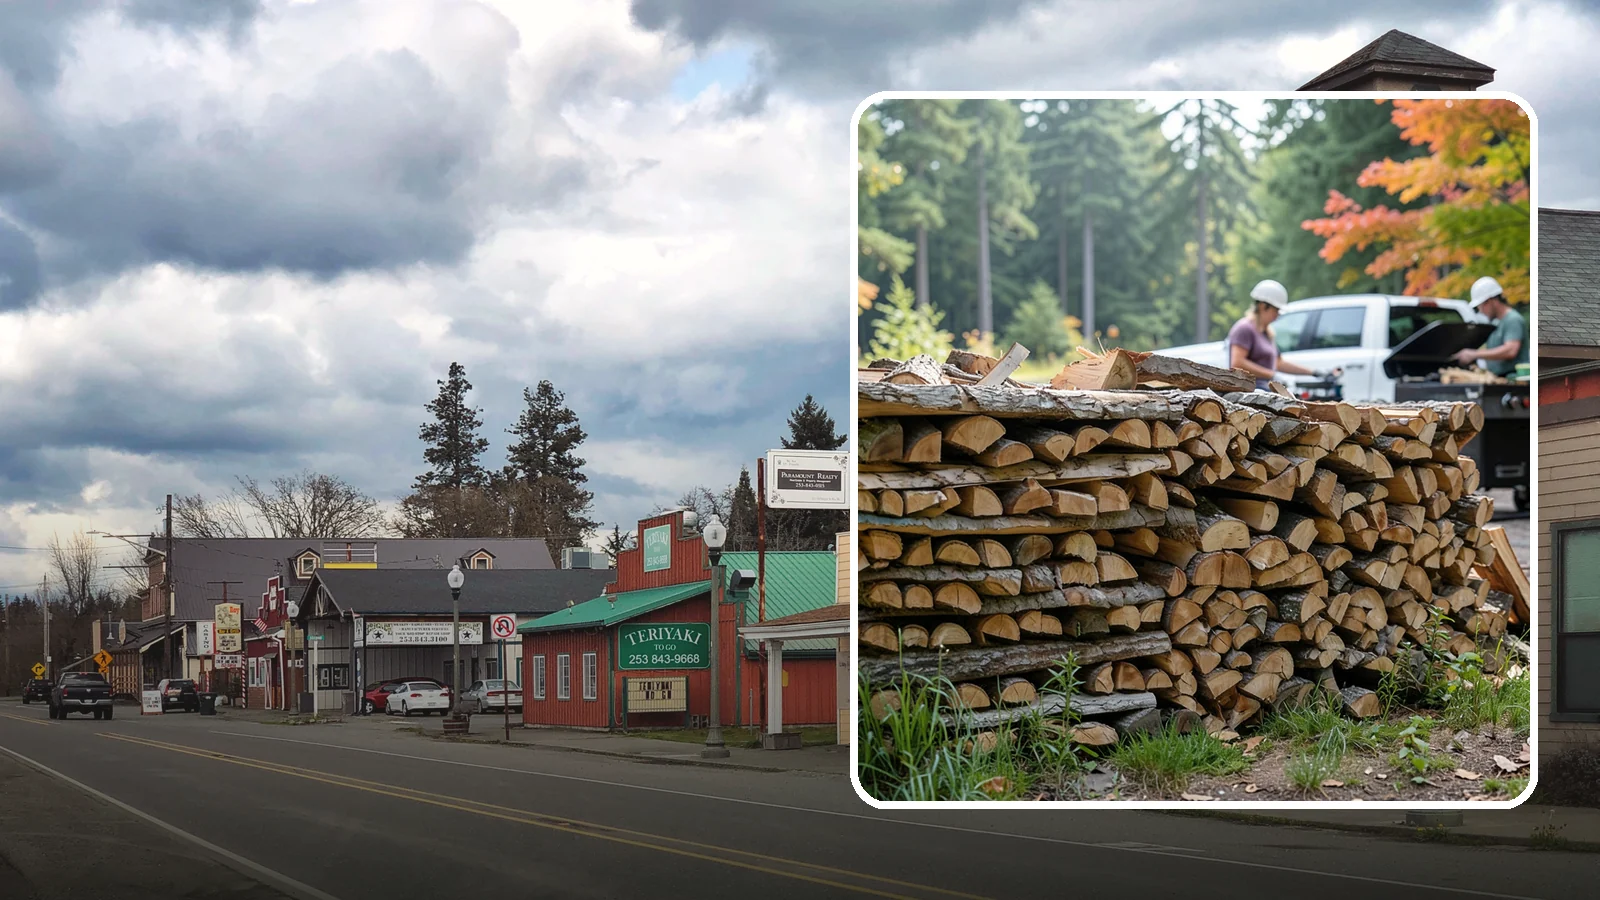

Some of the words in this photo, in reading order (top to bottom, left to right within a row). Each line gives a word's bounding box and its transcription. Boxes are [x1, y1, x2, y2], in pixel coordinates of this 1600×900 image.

[624, 627, 702, 646] TERIYAKI
[628, 654, 649, 666] 253
[651, 653, 700, 665] 843-9668
